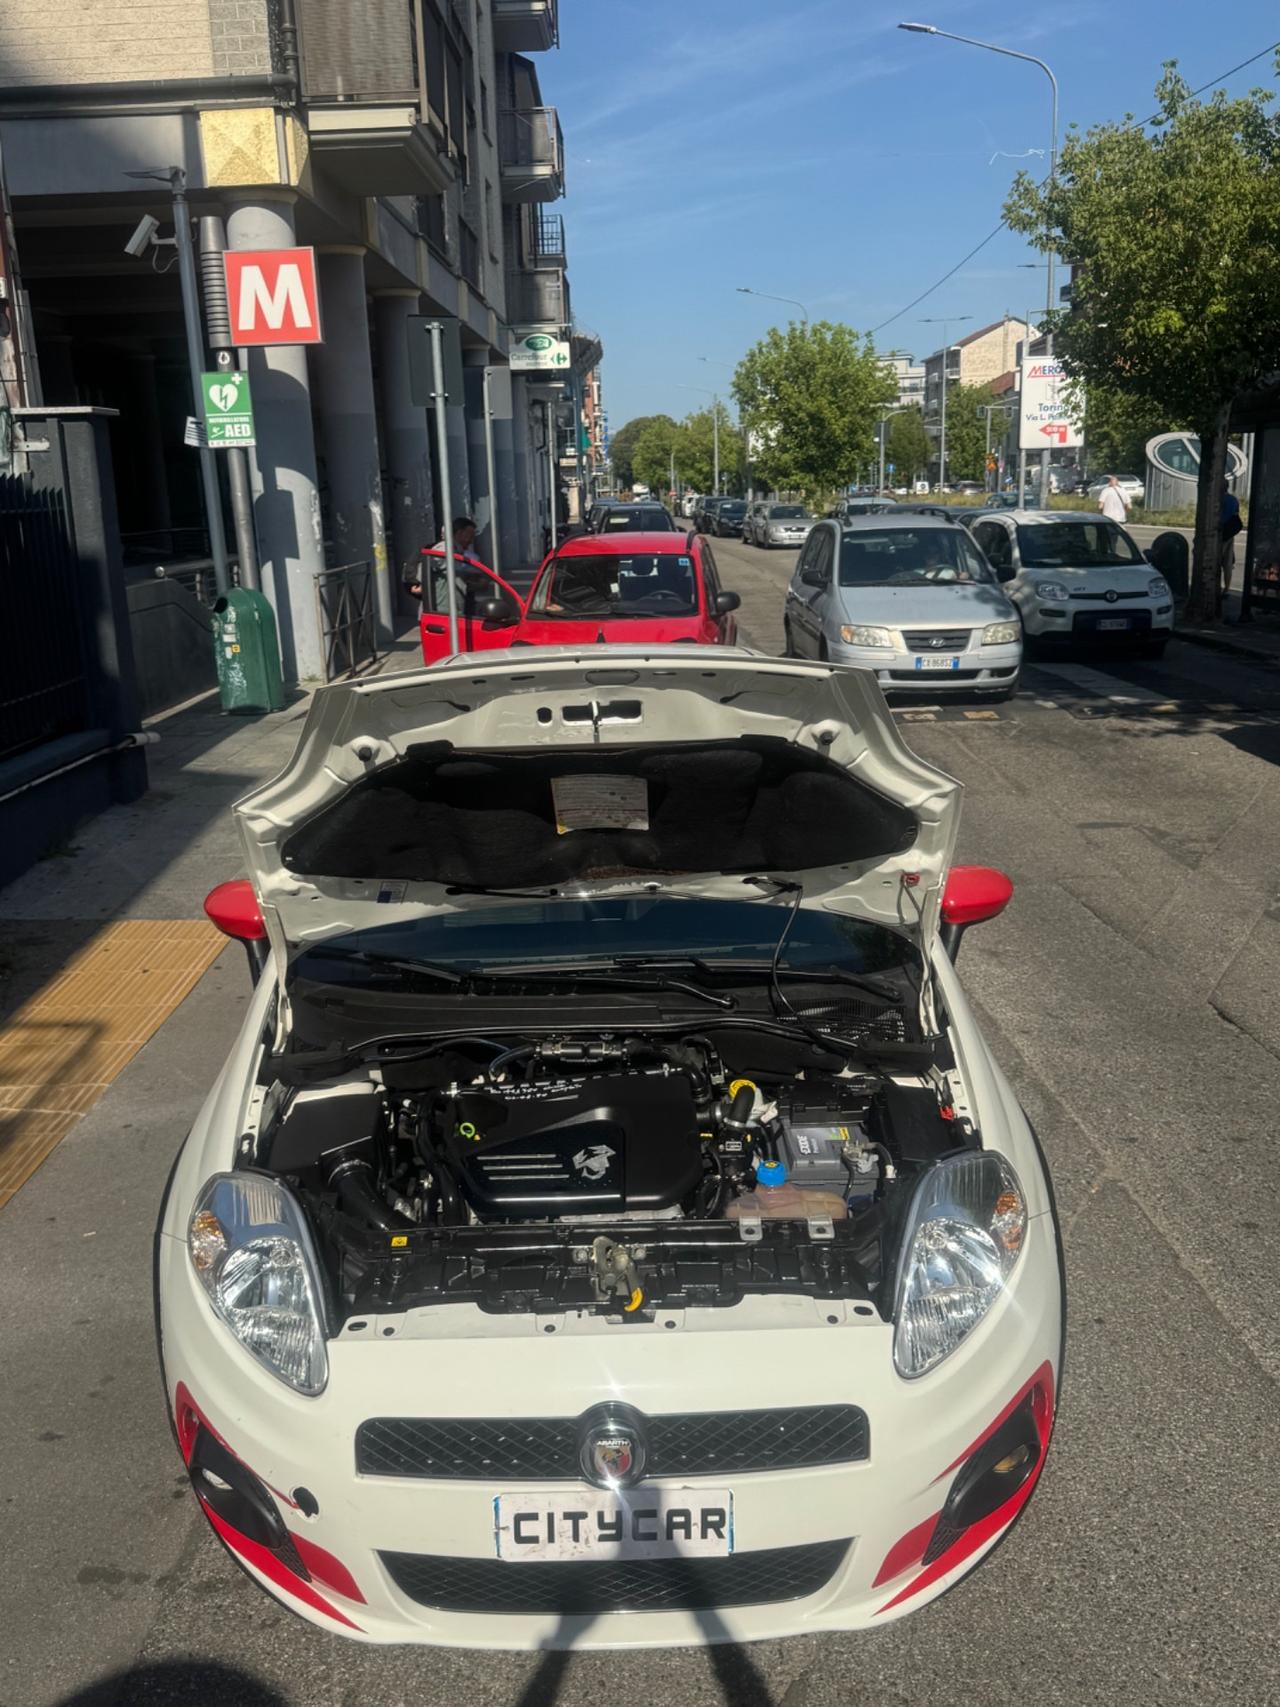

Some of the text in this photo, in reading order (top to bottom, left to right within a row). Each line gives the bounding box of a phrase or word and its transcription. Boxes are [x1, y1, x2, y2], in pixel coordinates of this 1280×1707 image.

[238, 264, 312, 331] M
[225, 423, 251, 437] AED
[513, 1508, 727, 1544] CITYCAR
